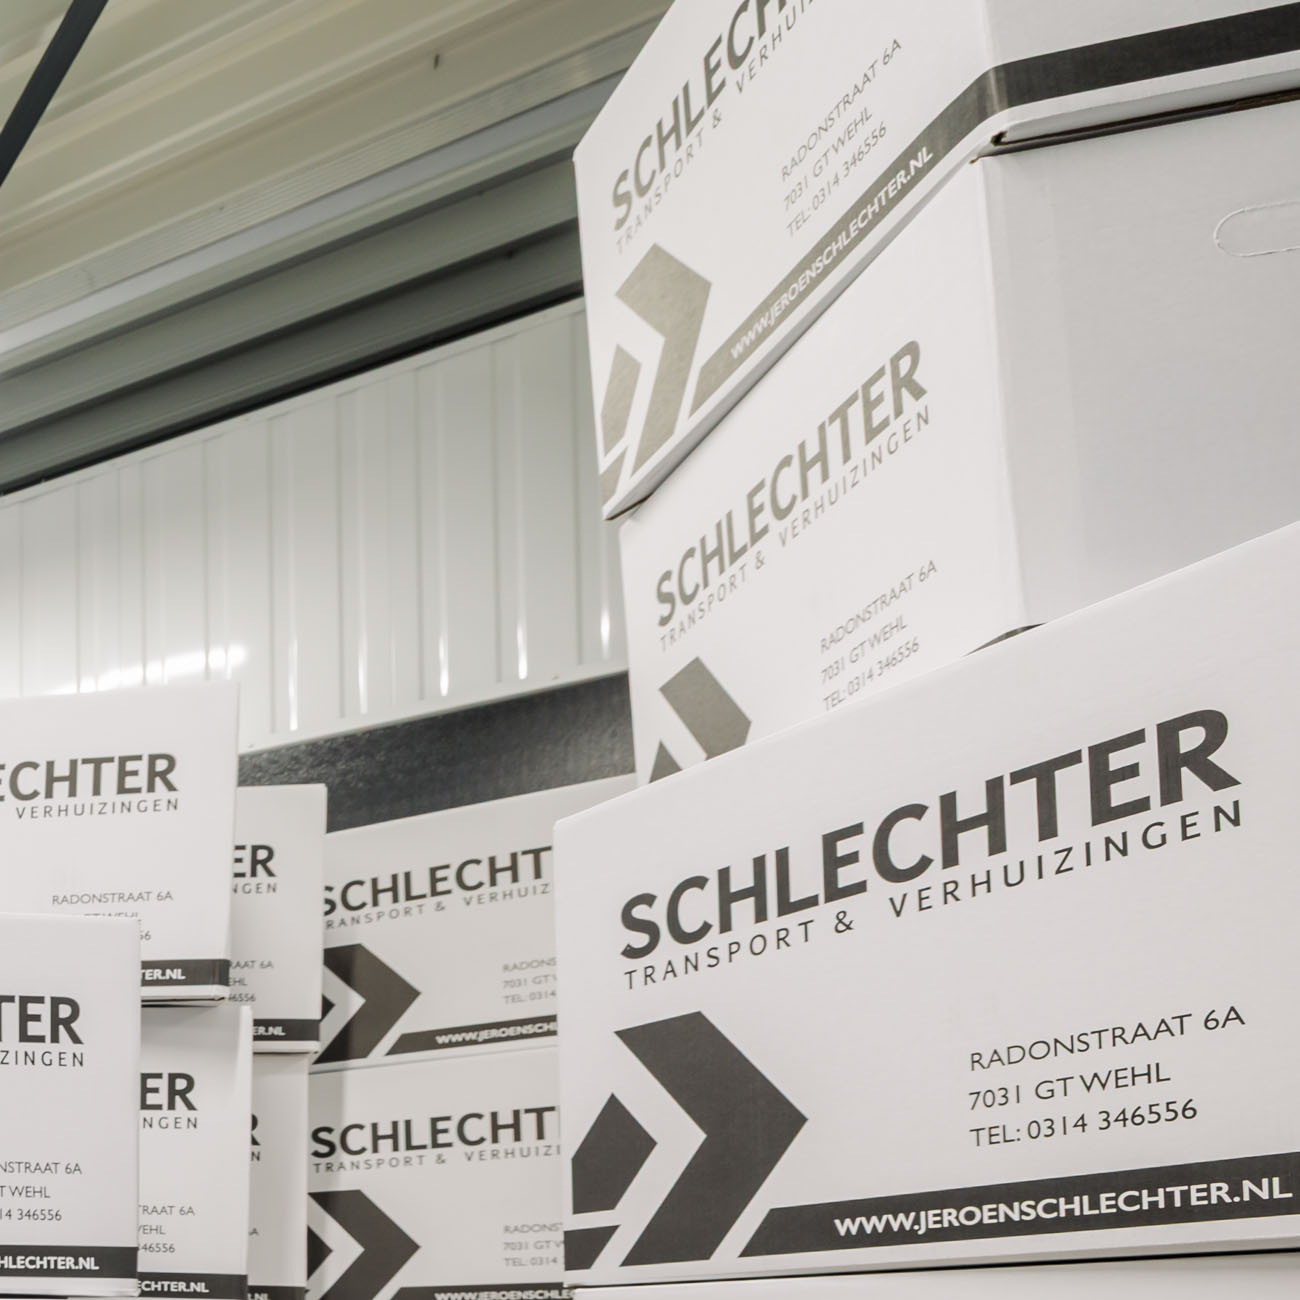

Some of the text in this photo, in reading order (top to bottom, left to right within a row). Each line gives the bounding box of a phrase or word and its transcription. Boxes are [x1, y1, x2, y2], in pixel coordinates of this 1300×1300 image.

[782, 37, 901, 181] RADONSTRAAT 6A
[615, 125, 702, 251] TRANSPORT
[784, 174, 808, 211] 7031
[832, 106, 872, 154] WEHL
[812, 172, 839, 211] 0314
[843, 122, 887, 178] 346556
[730, 147, 933, 360] WWW.JEROENSCHLECHTER.NL
[657, 340, 927, 627] SCHLECHTER
[660, 405, 929, 651] TRANSPORT & VERHUIZINGEN
[821, 560, 936, 653] RADONSTRAAT 6A
[821, 656, 844, 683] 7031
[868, 615, 907, 649] WEHL
[847, 667, 873, 695] 0314
[14, 798, 177, 819] VERHUIZINGEN
[621, 710, 1239, 959] SCHLECHTER
[51, 892, 173, 905] RADONSTRAAT 6A
[463, 883, 551, 908] VERHUIZ
[624, 801, 1240, 990] TRANSPORT & VERHUIZINGEN
[971, 1007, 1243, 1070] RADONSTRAAT 6A
[970, 1063, 1169, 1109] 7031 GT WEHL
[311, 1106, 558, 1158] SCHLECHT
[970, 1100, 1197, 1146] TEL: 0314 346556
[9, 1186, 50, 1198] WEHL
[65, 1163, 82, 1174] 6A
[313, 1154, 427, 1174] TRANSPORT
[18, 1208, 62, 1221] 346556
[835, 1176, 1293, 1235] WWW.JEROENSCHLECHTER.NL
